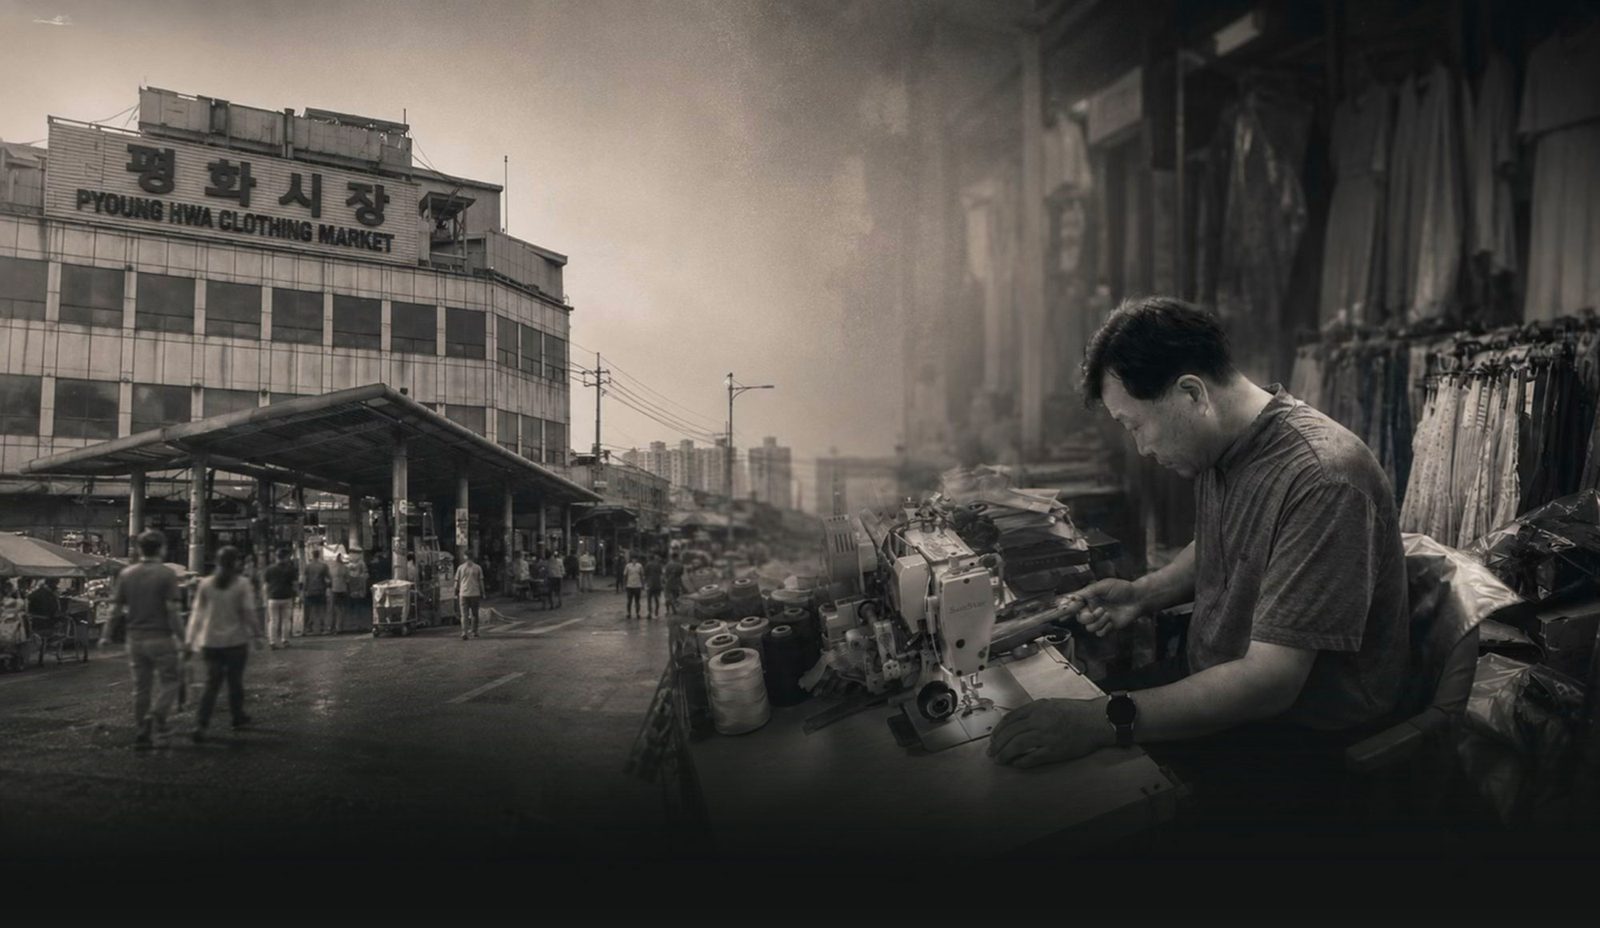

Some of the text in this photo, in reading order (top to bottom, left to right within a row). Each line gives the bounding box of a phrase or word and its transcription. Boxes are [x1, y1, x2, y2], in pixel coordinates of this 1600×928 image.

[77, 190, 395, 252] PYOUNG HWA CLOTHING MARKET
